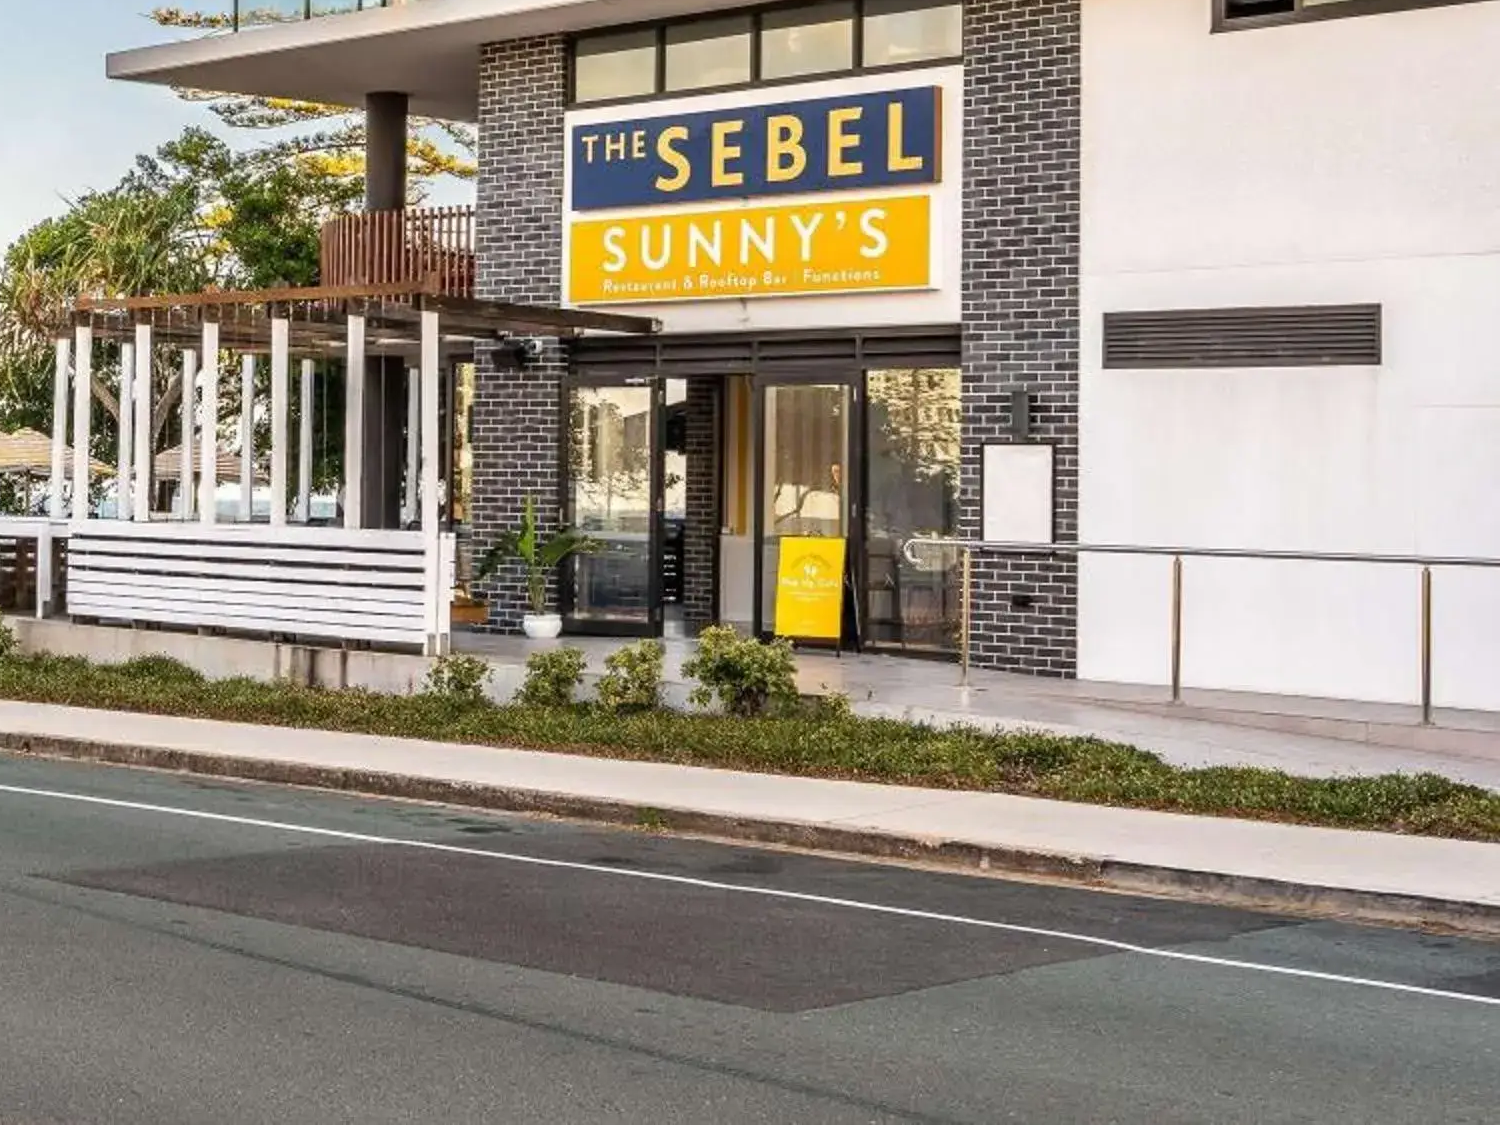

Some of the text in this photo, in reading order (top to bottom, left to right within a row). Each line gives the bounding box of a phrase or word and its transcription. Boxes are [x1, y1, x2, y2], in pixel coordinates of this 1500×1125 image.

[581, 101, 923, 192] THE SEBEL
[602, 208, 889, 273] SUNNY'S
[603, 268, 881, 293] Restaurant & Rooftop Bar Functions
